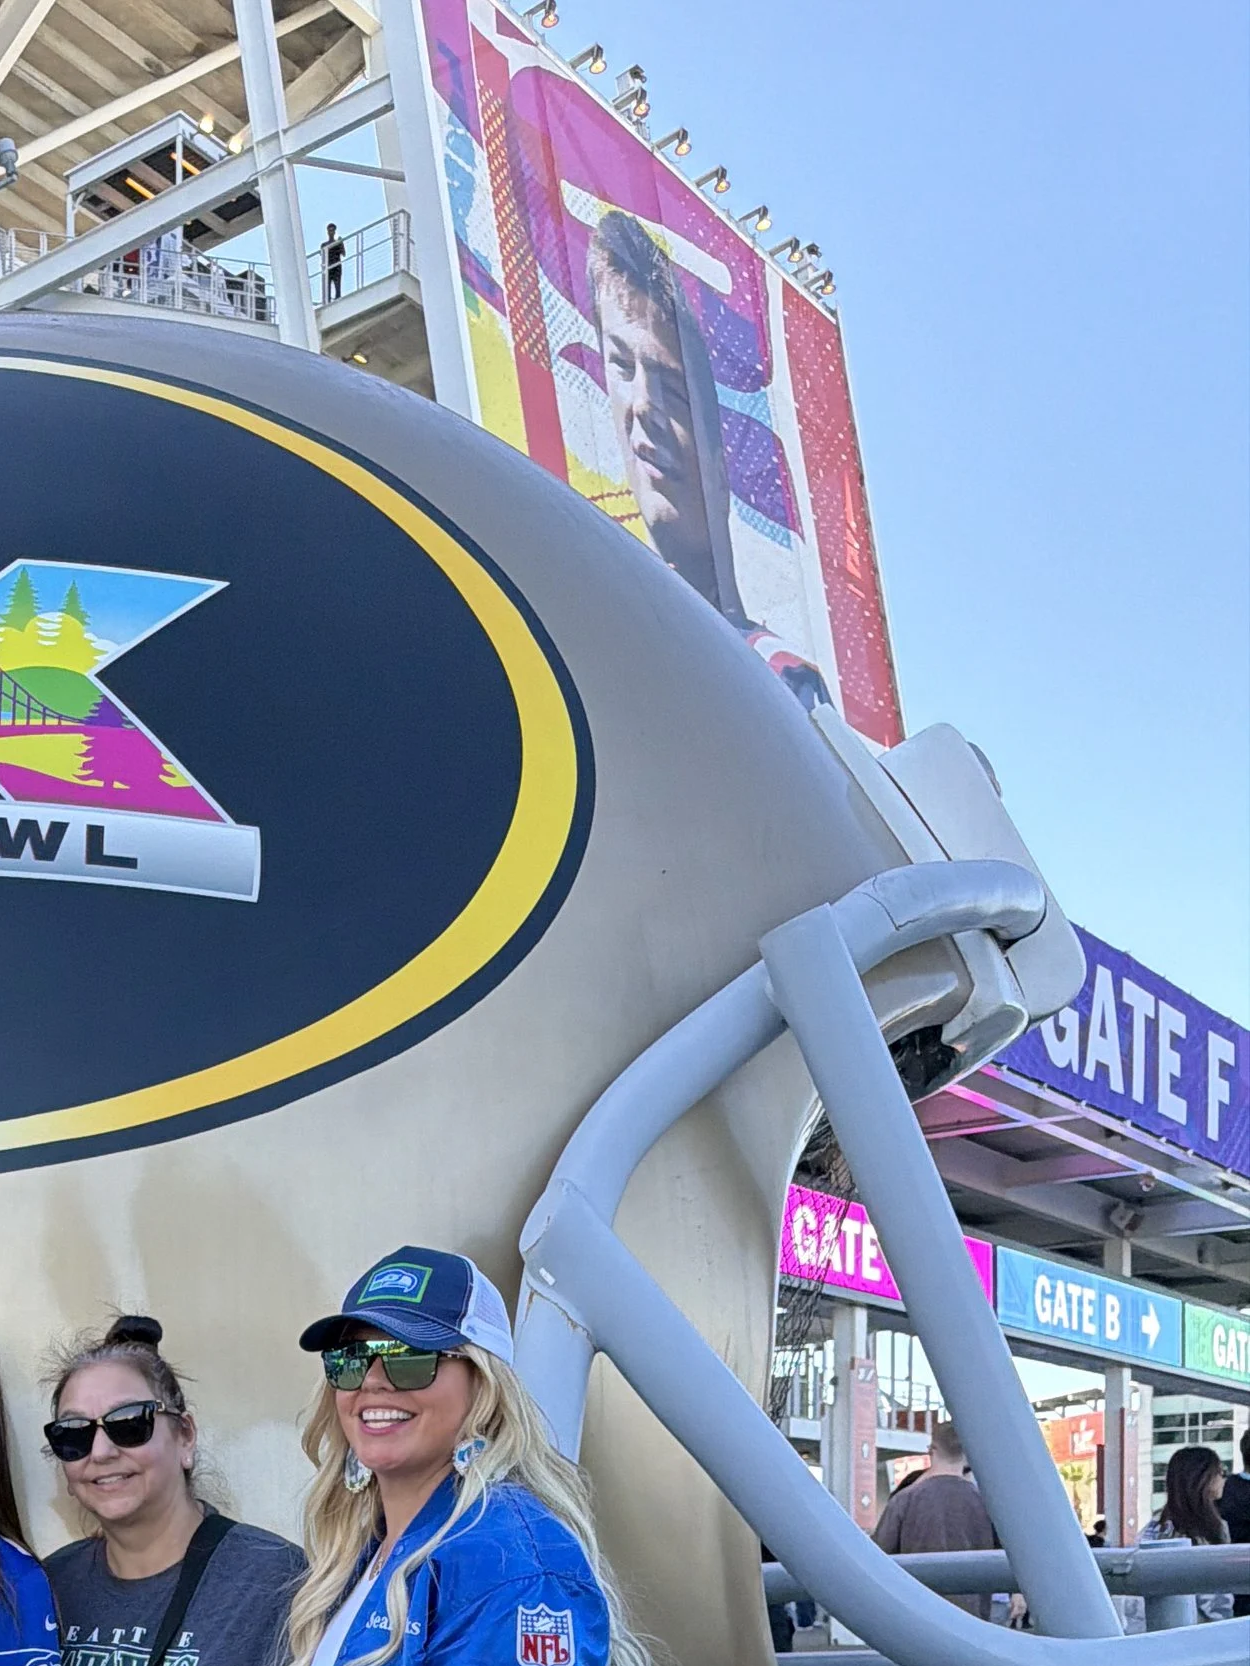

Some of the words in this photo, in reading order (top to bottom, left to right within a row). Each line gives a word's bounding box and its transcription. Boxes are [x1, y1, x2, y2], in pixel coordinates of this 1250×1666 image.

[1040, 963, 1187, 1126] GATE
[1207, 1030, 1236, 1142] F
[792, 1205, 882, 1282] GATE
[1034, 1275, 1097, 1337] GATE
[1105, 1293, 1122, 1342] B
[1213, 1323, 1250, 1374] GAT
[521, 1634, 569, 1666] NFL
